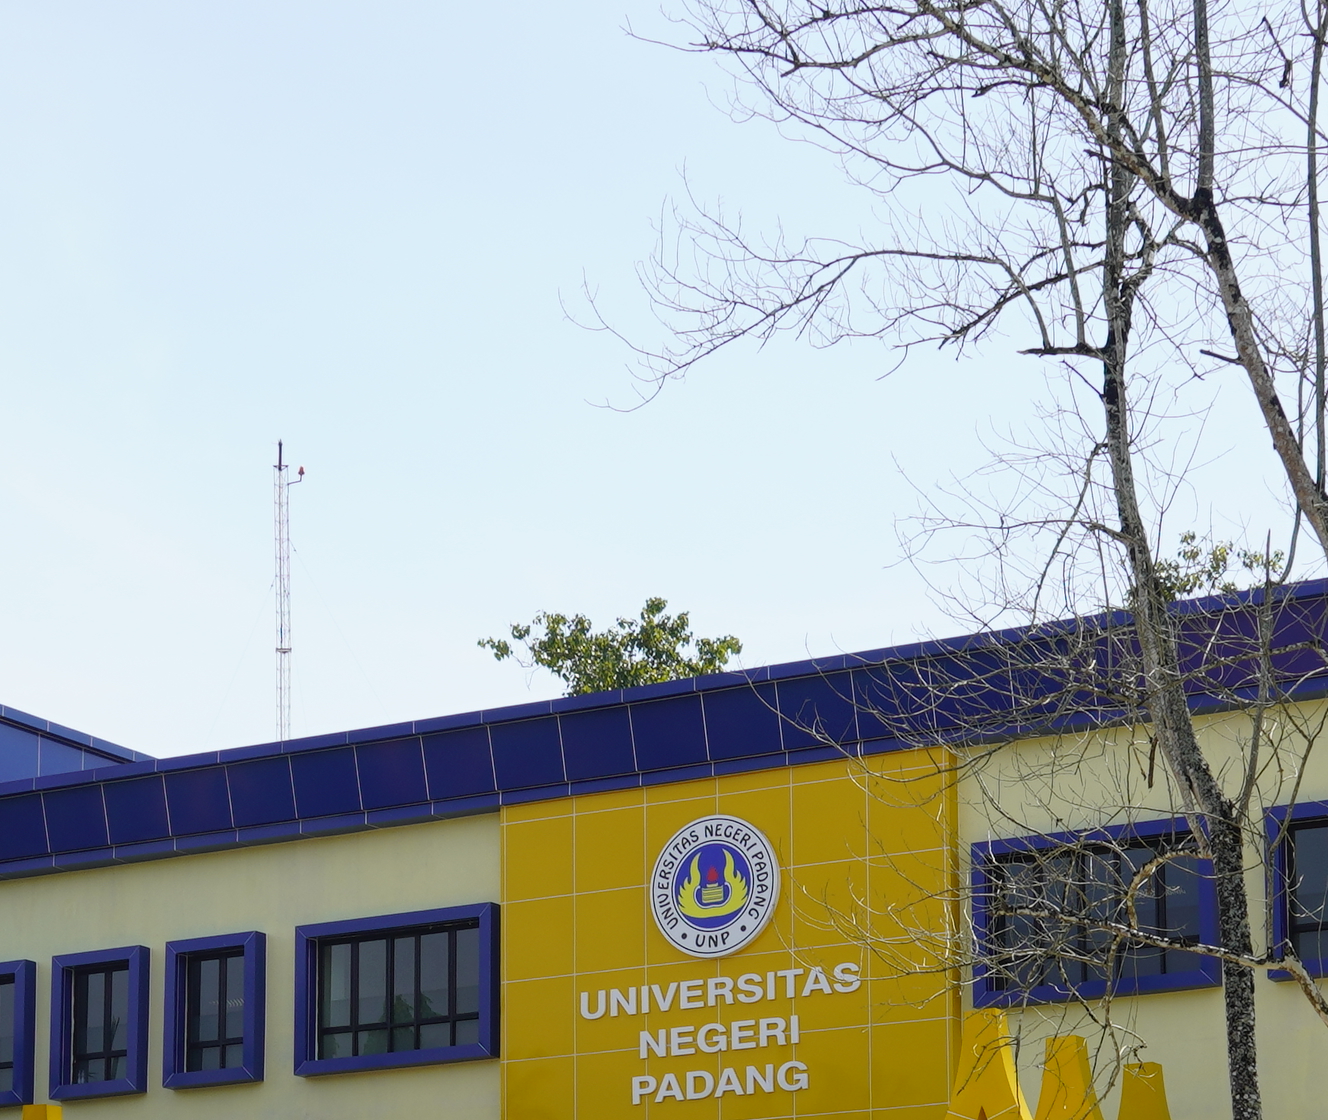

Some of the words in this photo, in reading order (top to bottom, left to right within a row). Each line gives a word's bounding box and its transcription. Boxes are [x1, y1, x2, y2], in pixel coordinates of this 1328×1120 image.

[657, 830, 699, 930] UNIVERSITAS
[704, 823, 757, 852] NEGERI
[748, 850, 769, 920] PADANG
[695, 931, 730, 948] UNP
[579, 962, 862, 1020] UNIVERSITAS
[639, 1014, 800, 1059] NEGERI
[631, 1060, 810, 1105] PADANG
